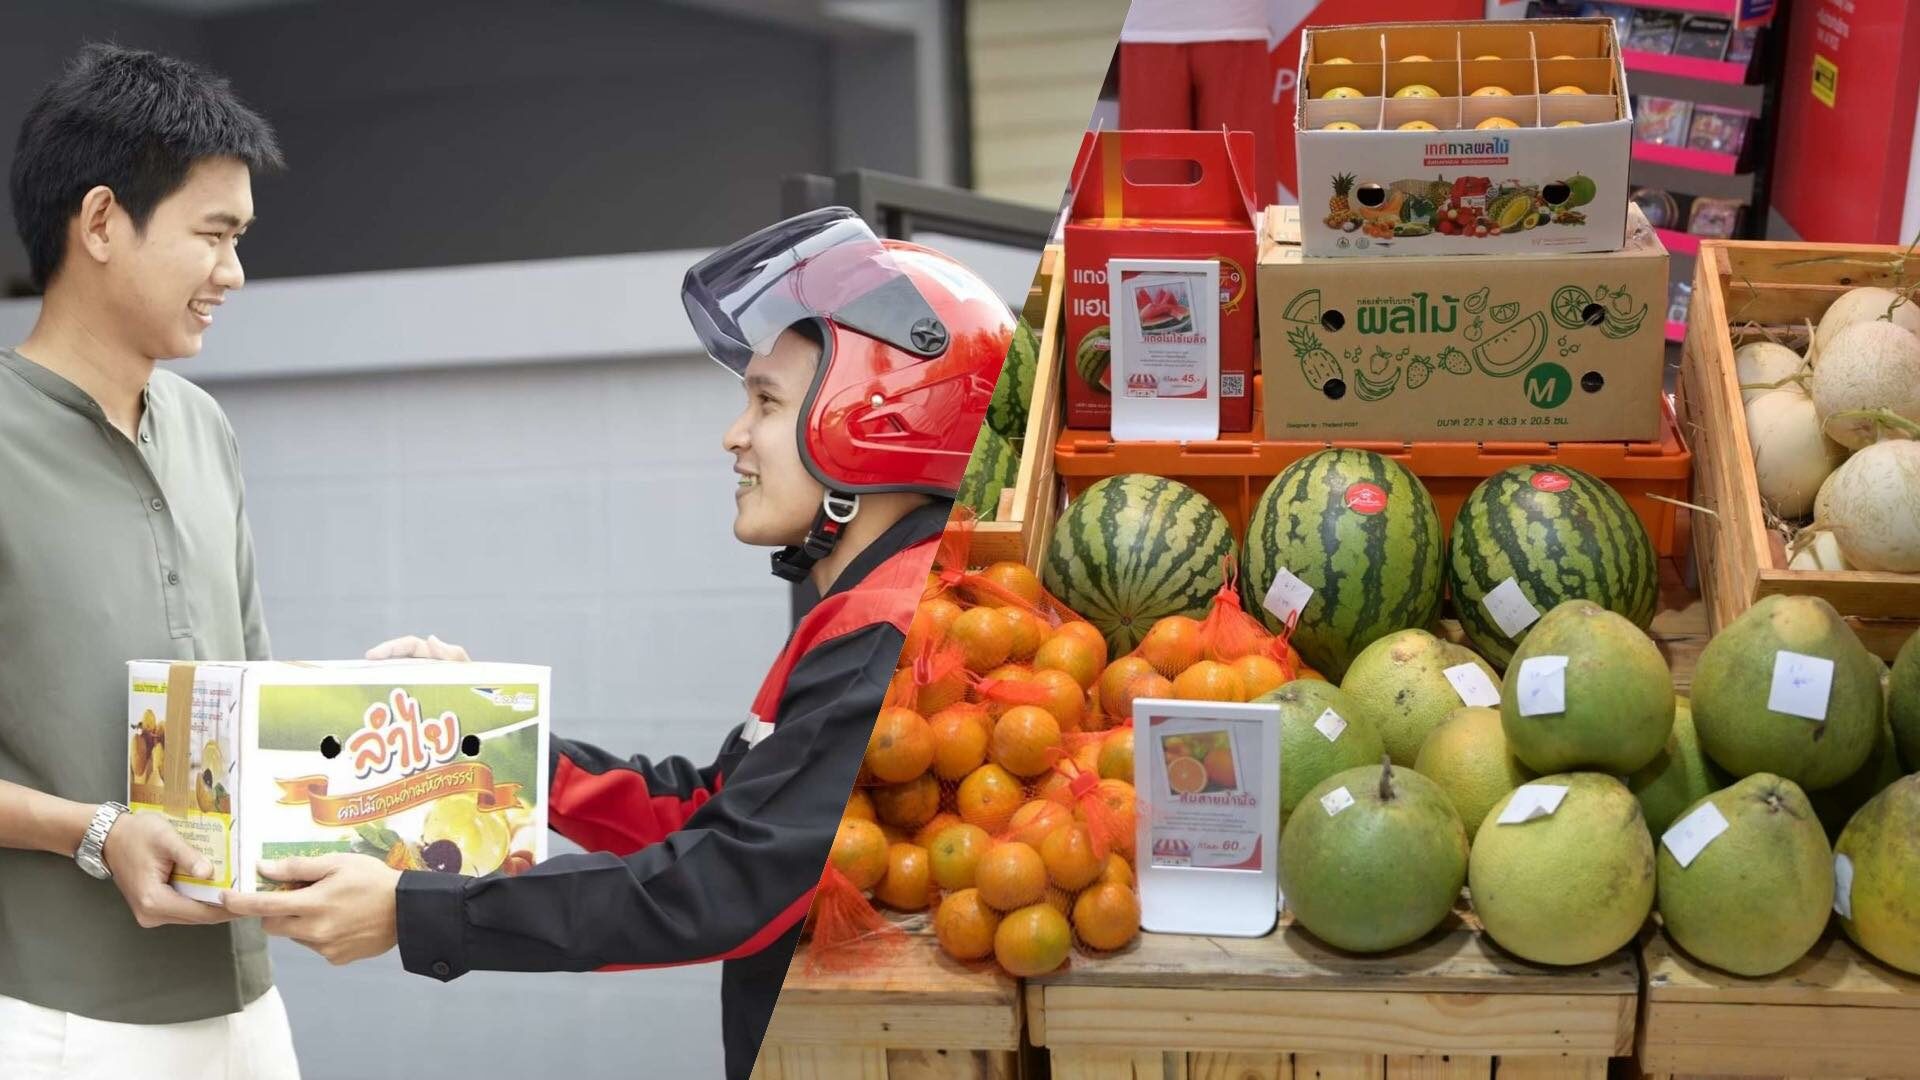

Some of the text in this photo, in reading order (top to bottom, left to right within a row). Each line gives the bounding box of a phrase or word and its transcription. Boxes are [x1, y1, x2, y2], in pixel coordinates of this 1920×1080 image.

[1424, 136, 1510, 155] เทศกาลผลไม้
[1073, 262, 1108, 285] แตง
[1356, 291, 1460, 335] ผลไม้
[1526, 377, 1557, 402] M
[1463, 417, 1484, 427] 27.3
[1497, 416, 1518, 426] 43.3
[1530, 416, 1551, 426] 20.5
[346, 689, 458, 773] ลำไย
[337, 767, 475, 820] ผลไม้คุณค่ามหัศจรรย์
